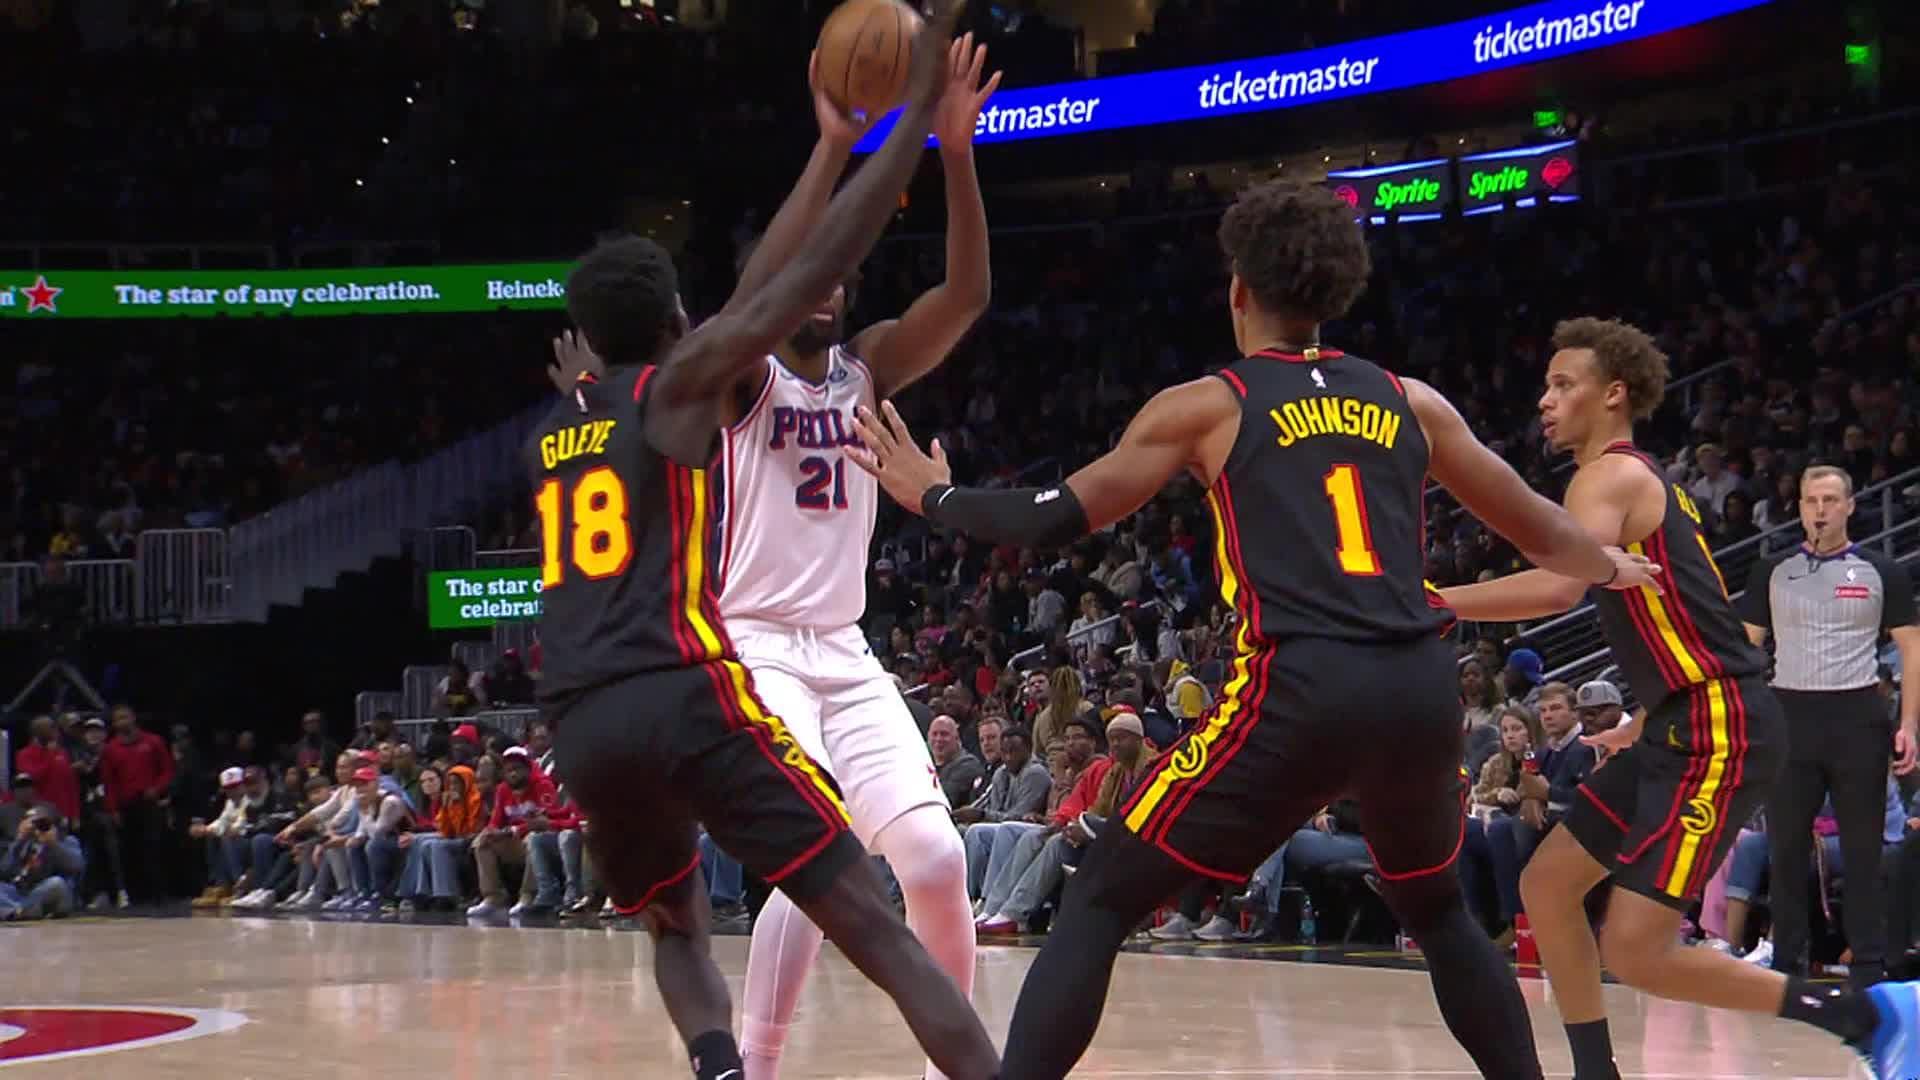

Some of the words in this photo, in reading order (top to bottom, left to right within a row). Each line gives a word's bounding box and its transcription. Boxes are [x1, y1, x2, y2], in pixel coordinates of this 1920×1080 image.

[1473, 0, 1645, 64] ticketmaster
[1198, 58, 1379, 109] ticketmaster
[1374, 179, 1441, 211] Sprite
[1468, 166, 1529, 200] Sprite
[114, 283, 161, 304] The
[167, 284, 218, 304] star
[223, 282, 250, 304] of
[254, 286, 297, 308] any
[302, 280, 440, 303] celebration.
[487, 279, 566, 299] Heinek
[540, 420, 616, 470] GUEYE
[769, 406, 867, 451] PHIL
[1269, 397, 1400, 449] JOHNSON
[795, 455, 850, 511] 21
[534, 465, 634, 590] 18
[1322, 463, 1384, 577] 1
[445, 578, 483, 597] The
[487, 577, 528, 595] star
[532, 578, 545, 593] o
